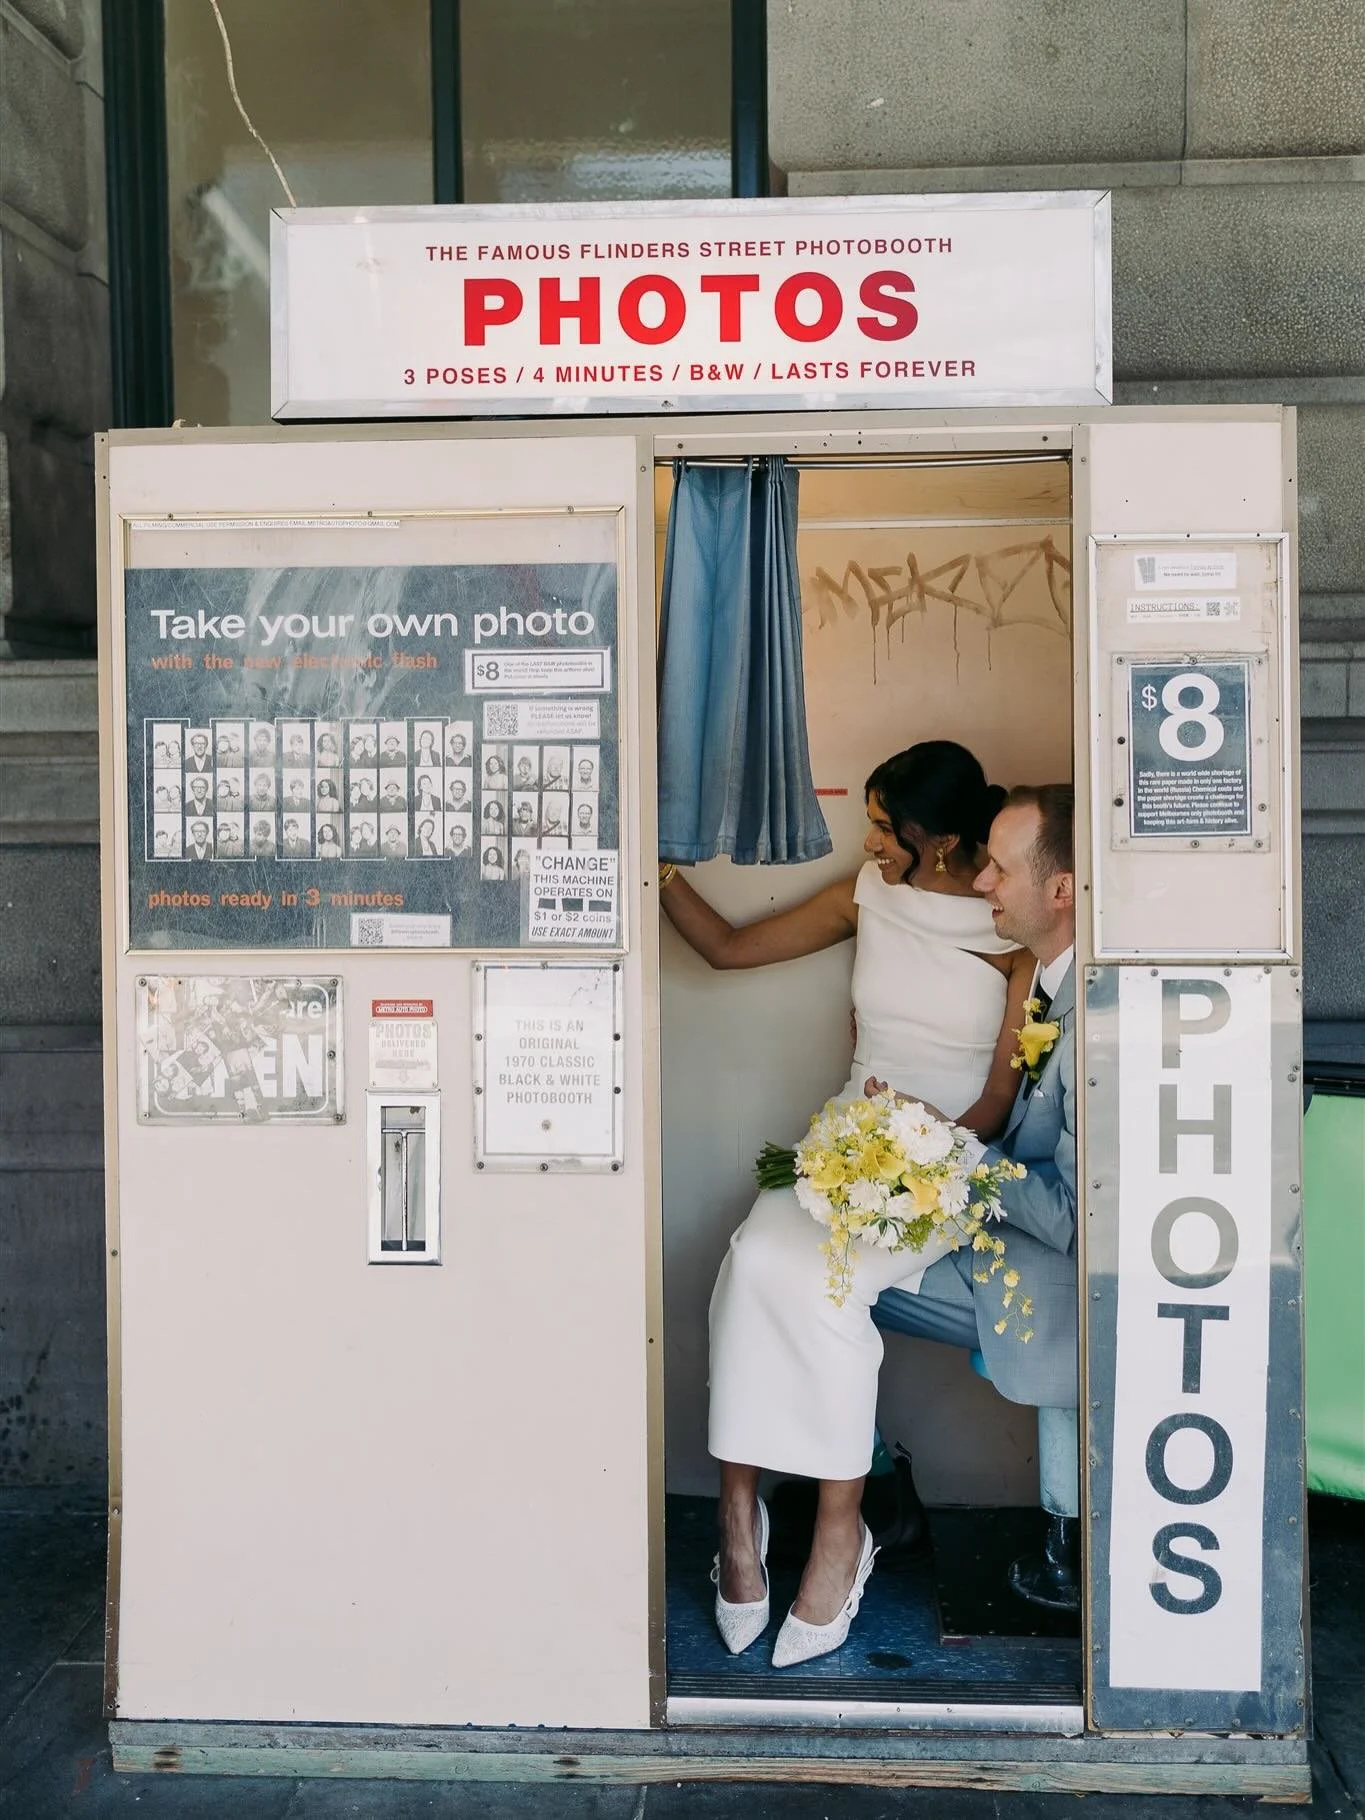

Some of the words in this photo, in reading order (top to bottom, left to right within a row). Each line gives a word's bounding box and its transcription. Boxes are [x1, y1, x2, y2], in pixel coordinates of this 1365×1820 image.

[426, 246, 468, 261] THE
[478, 244, 571, 261] FAMOUS
[580, 242, 690, 259] FLINDERS
[699, 240, 786, 257] STREET
[795, 238, 953, 256] PHOTOBOOTH
[464, 270, 918, 346] PHOTOS
[404, 368, 415, 385] 3
[426, 367, 507, 385] POSES
[516, 367, 524, 383] /
[533, 367, 545, 383] 4
[556, 365, 663, 383] MINUTES
[672, 364, 680, 381] /
[690, 363, 745, 381] B&W
[753, 363, 762, 380] /
[771, 362, 849, 380] LASTS
[860, 360, 976, 378] FOREVER
[1130, 602, 1199, 612] INSTRUCTIONS:
[150, 609, 246, 640] Take
[259, 613, 355, 646] your
[367, 612, 458, 638] own
[474, 606, 595, 644] photo
[152, 653, 193, 670] with
[203, 653, 234, 670] the
[243, 655, 281, 669] new
[391, 651, 439, 669] flash
[477, 661, 500, 681] $8
[1141, 673, 1224, 762] $8
[536, 855, 616, 871] "CHANGE"
[533, 874, 559, 884] THIS
[562, 875, 614, 886] MACHINE
[148, 888, 211, 910] photos
[220, 889, 272, 910] ready
[281, 890, 298, 906] in
[305, 888, 320, 906] 3
[330, 890, 405, 906] minutes
[534, 886, 593, 897] OPERATES
[596, 888, 613, 898] ON
[534, 911, 547, 921] $1
[551, 912, 562, 921] or
[565, 911, 580, 922] $2
[582, 913, 612, 923] coins
[531, 926, 548, 937] USE
[549, 926, 577, 938] EXACT
[577, 927, 614, 939] AMOUNT
[376, 1023, 431, 1039] PHOTOS
[515, 1020, 544, 1031] THIS
[550, 1019, 561, 1031] IS
[567, 1019, 584, 1031] AN
[382, 1040, 426, 1048] DELIVERED
[519, 1037, 580, 1049] ORIGINAL
[506, 1056, 535, 1067] 1970
[540, 1055, 595, 1068] CLASSIC
[498, 1073, 541, 1085] BLACK
[546, 1074, 555, 1085] &
[560, 1074, 601, 1086] WHITE
[507, 1092, 592, 1104] PHOTOBOOTH
[1145, 979, 1239, 1615] PHOTOS
